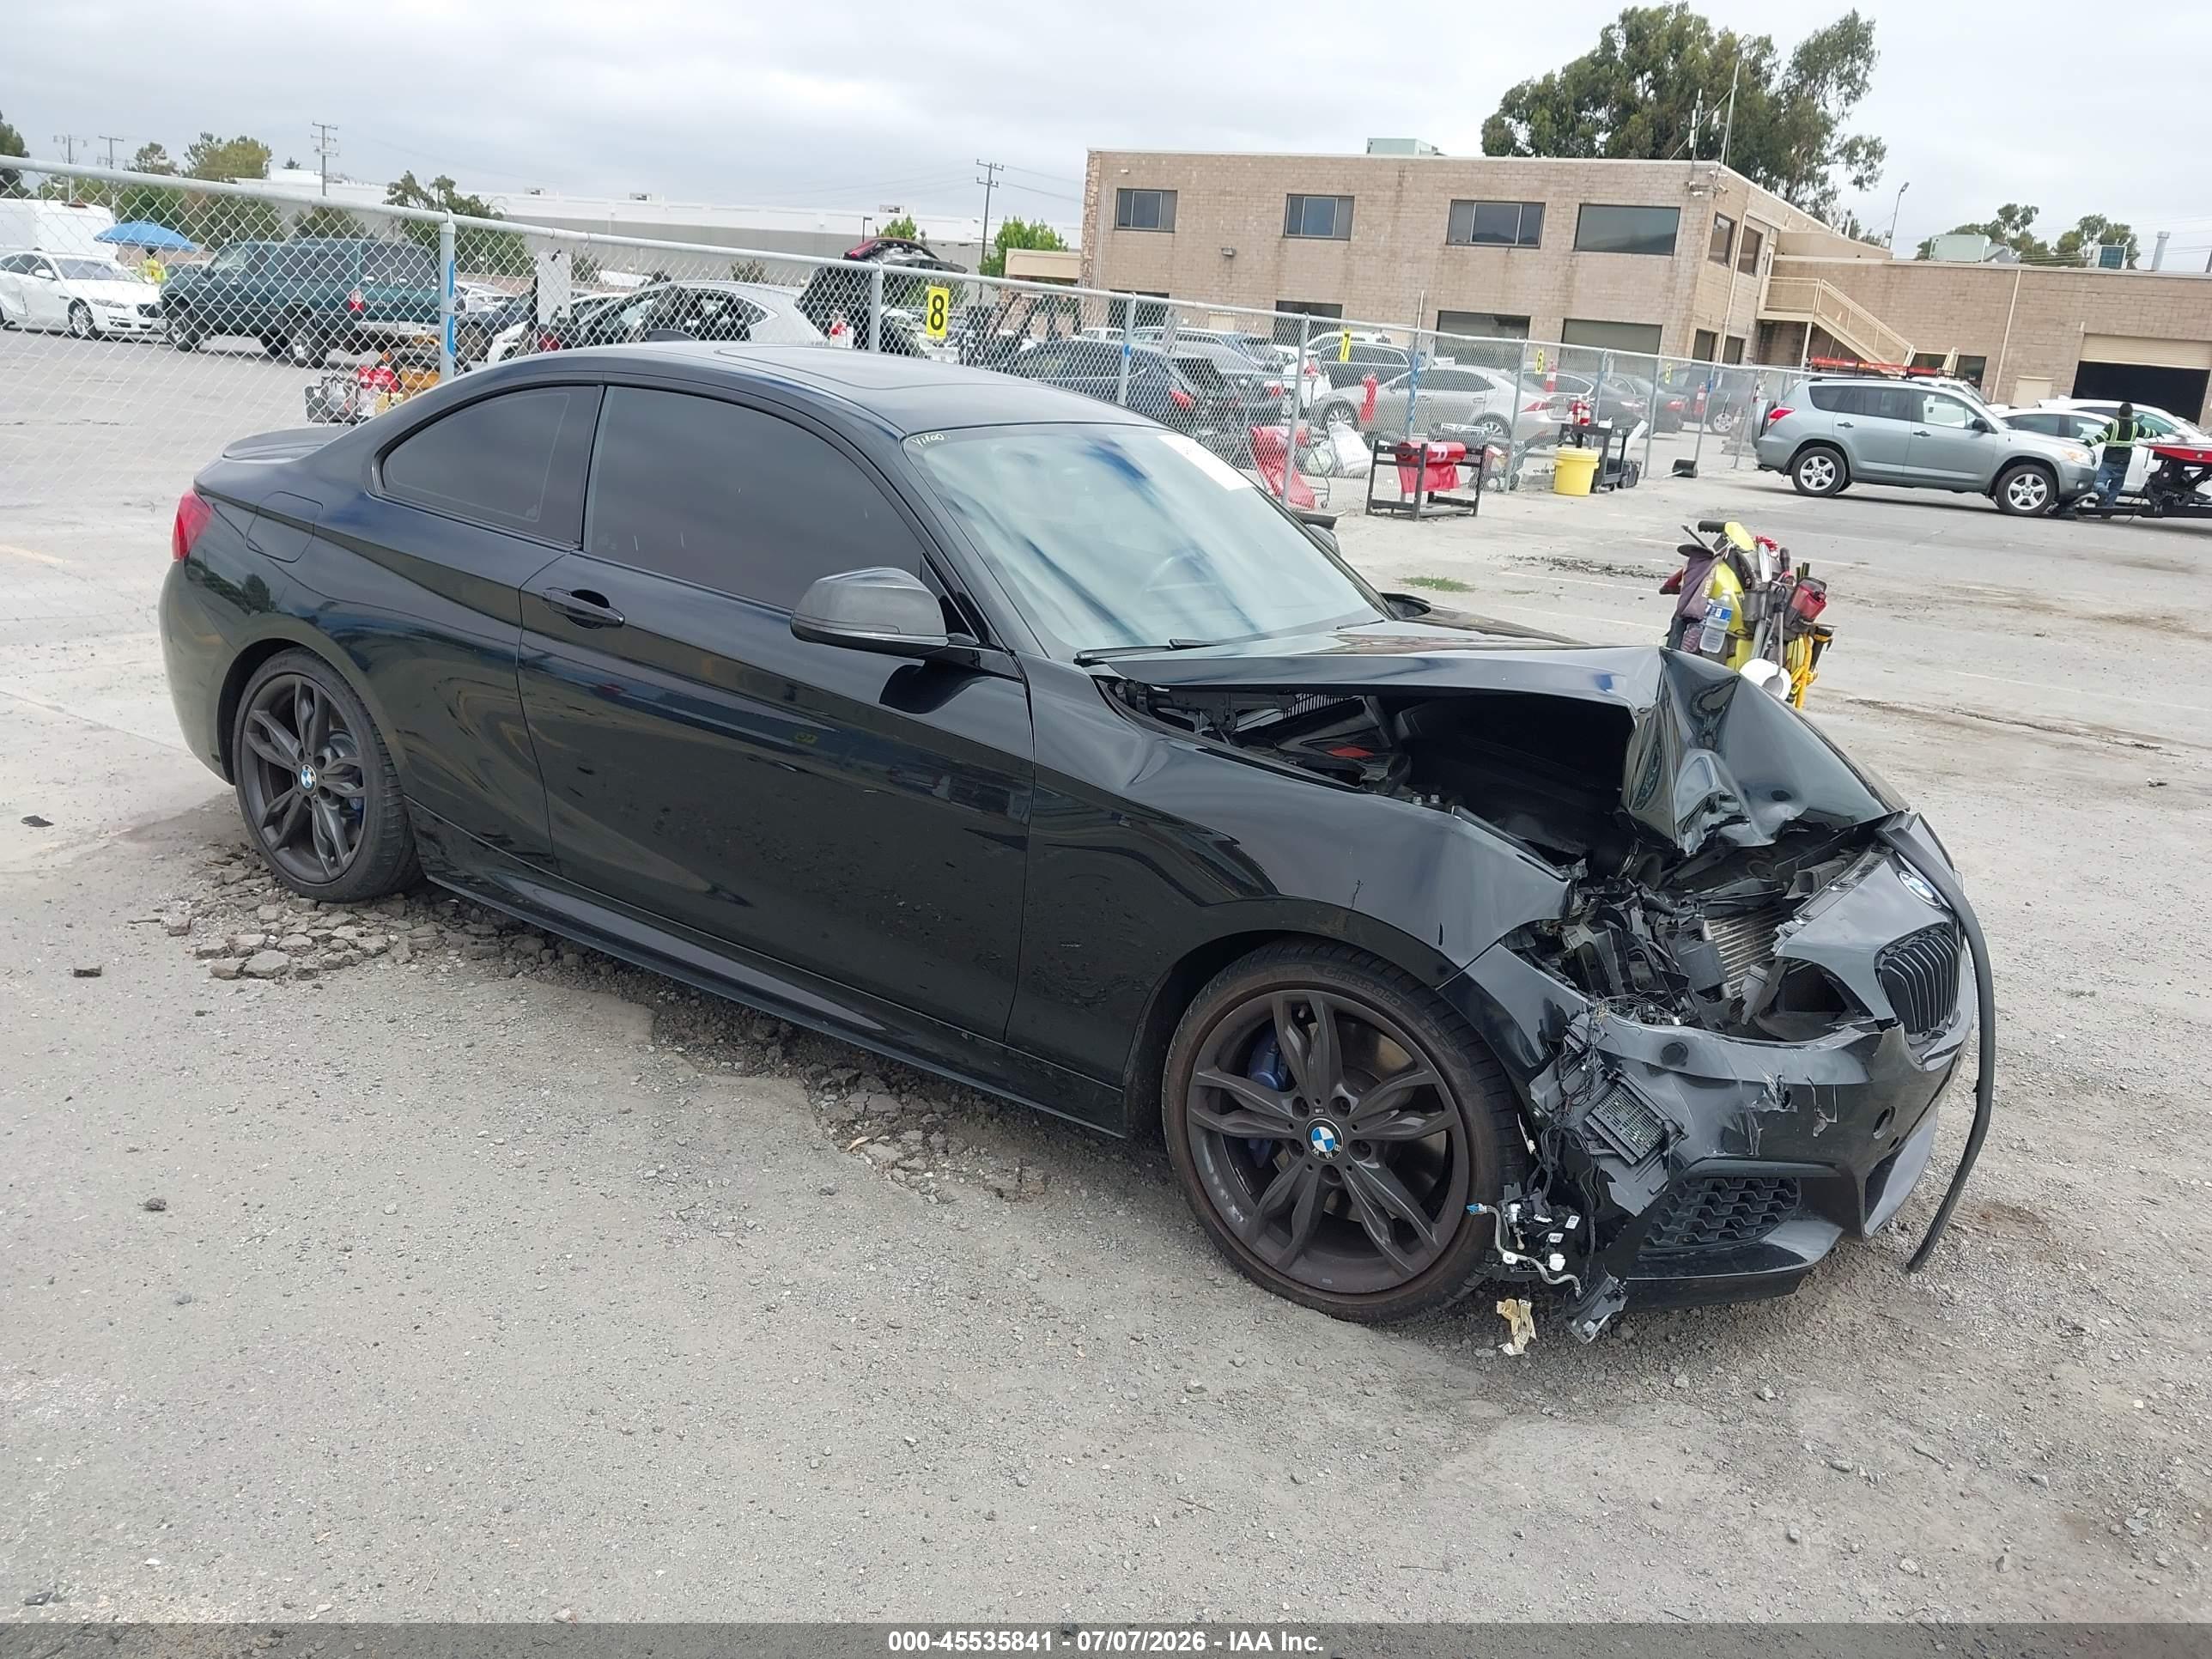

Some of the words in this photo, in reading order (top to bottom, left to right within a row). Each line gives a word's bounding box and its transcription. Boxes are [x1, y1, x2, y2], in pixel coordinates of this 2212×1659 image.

[930, 294, 945, 331] 8
[1342, 332, 1350, 358] 7
[1537, 351, 1543, 371] 6
